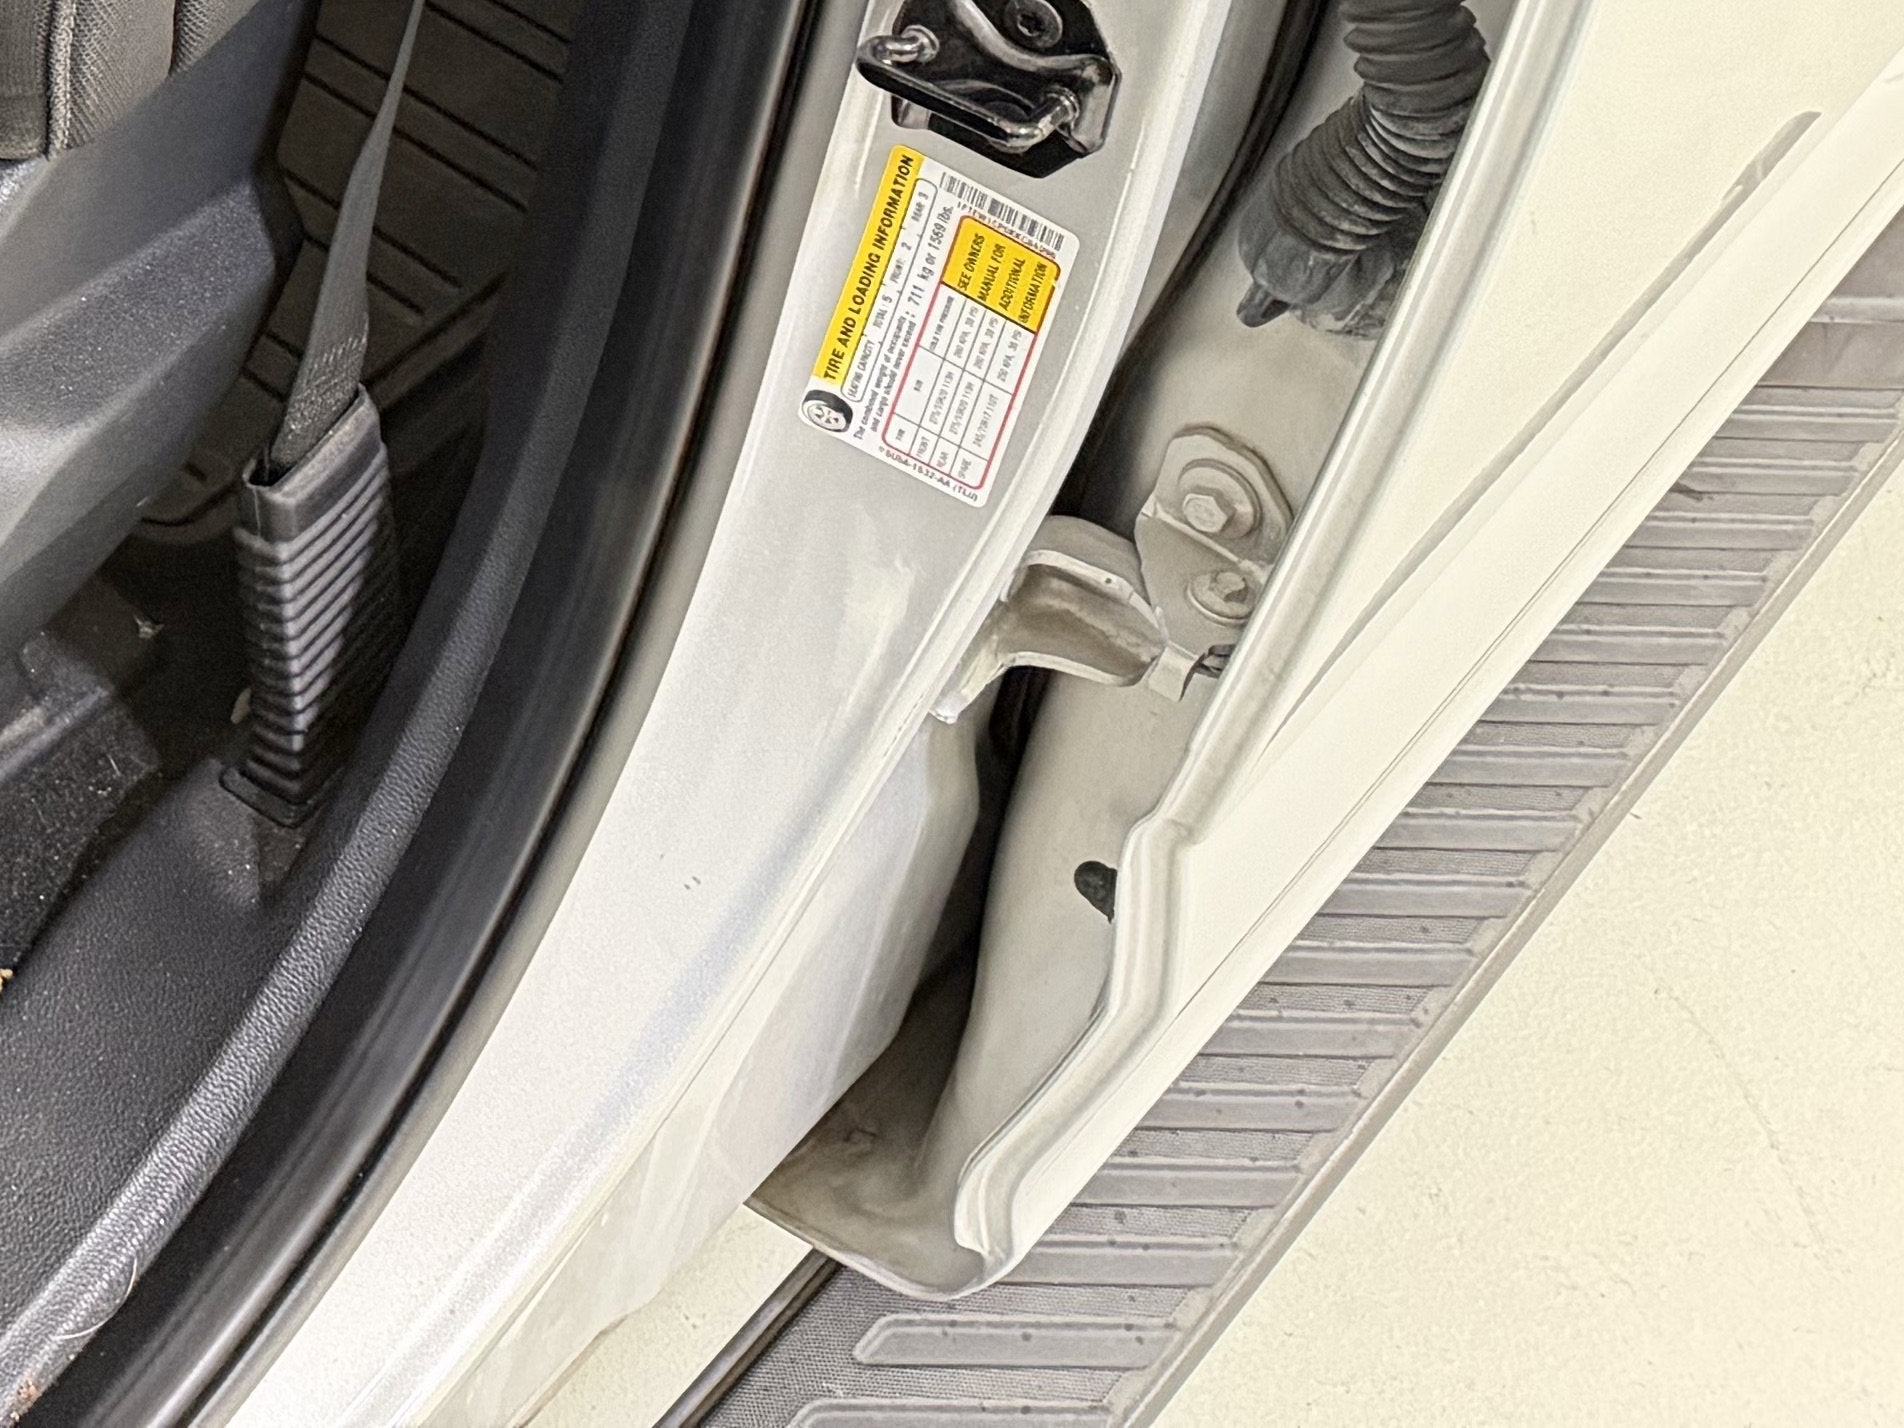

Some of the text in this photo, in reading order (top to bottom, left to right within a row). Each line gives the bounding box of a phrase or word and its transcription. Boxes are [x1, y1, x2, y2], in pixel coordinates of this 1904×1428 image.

[935, 201, 954, 224] lbs.
[822, 153, 915, 382] TIRE AND LOADING INFORMATION
[916, 264, 935, 283] kg
[923, 251, 937, 266] or
[956, 231, 986, 291] SEE OWNERS
[976, 242, 1006, 303] MANUAL FOR
[997, 254, 1026, 311] ADDITIONAL
[906, 283, 925, 307] 711
[1016, 260, 1048, 324] INFORMATION
[852, 314, 907, 440] The combined weight of occupants
[869, 319, 917, 433] and cargo should never exceed
